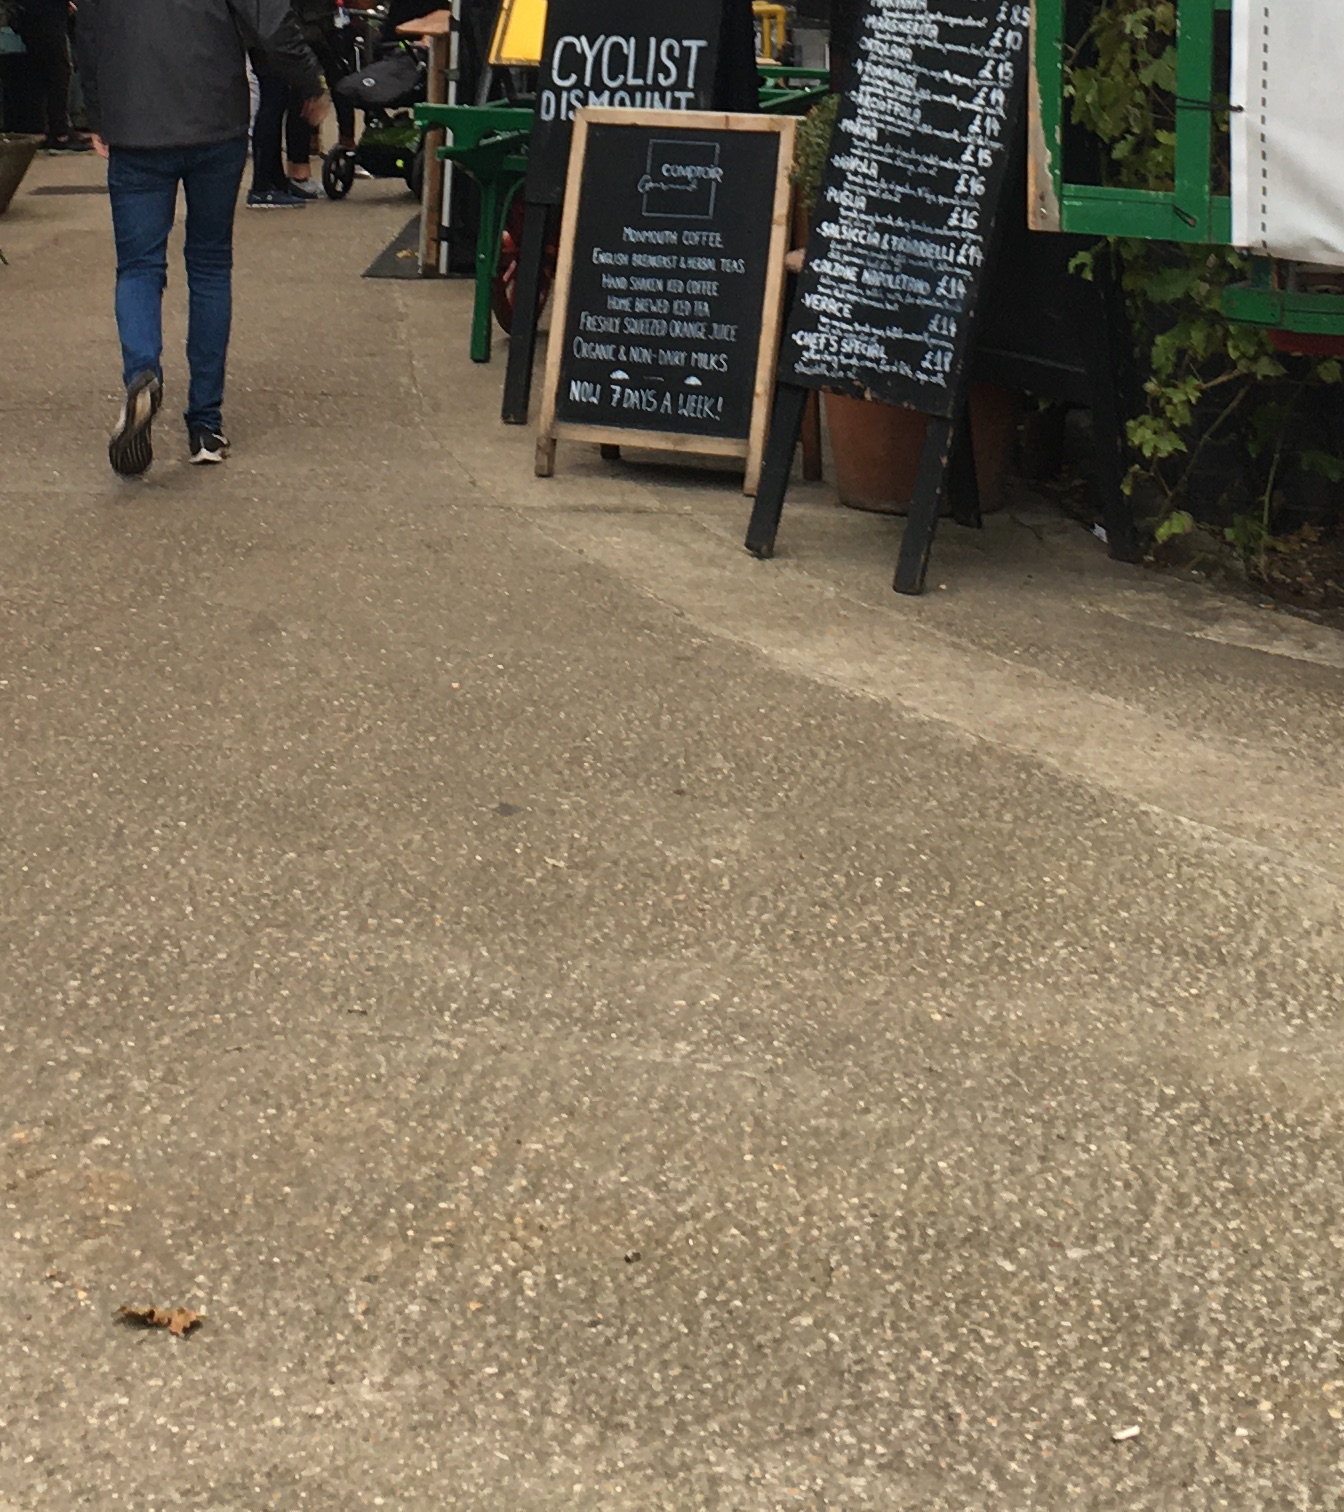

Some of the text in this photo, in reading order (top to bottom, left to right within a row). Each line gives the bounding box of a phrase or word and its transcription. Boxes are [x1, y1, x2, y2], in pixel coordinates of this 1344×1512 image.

[552, 34, 708, 88] CYCLIST
[682, 230, 724, 248] COFFEE
[592, 247, 629, 266] ENGLISH
[720, 258, 745, 274] TEAS
[686, 279, 720, 296] COFFEE
[579, 311, 621, 334] FRESHLY
[669, 319, 707, 339] ORANGE
[708, 322, 738, 342] JUICE
[573, 336, 617, 361] ORGANIC
[618, 345, 627, 361] &
[690, 351, 729, 372] MILKS
[569, 379, 601, 405] NOW
[610, 384, 622, 407] 7
[622, 388, 657, 412] DAYS
[660, 391, 672, 414] A
